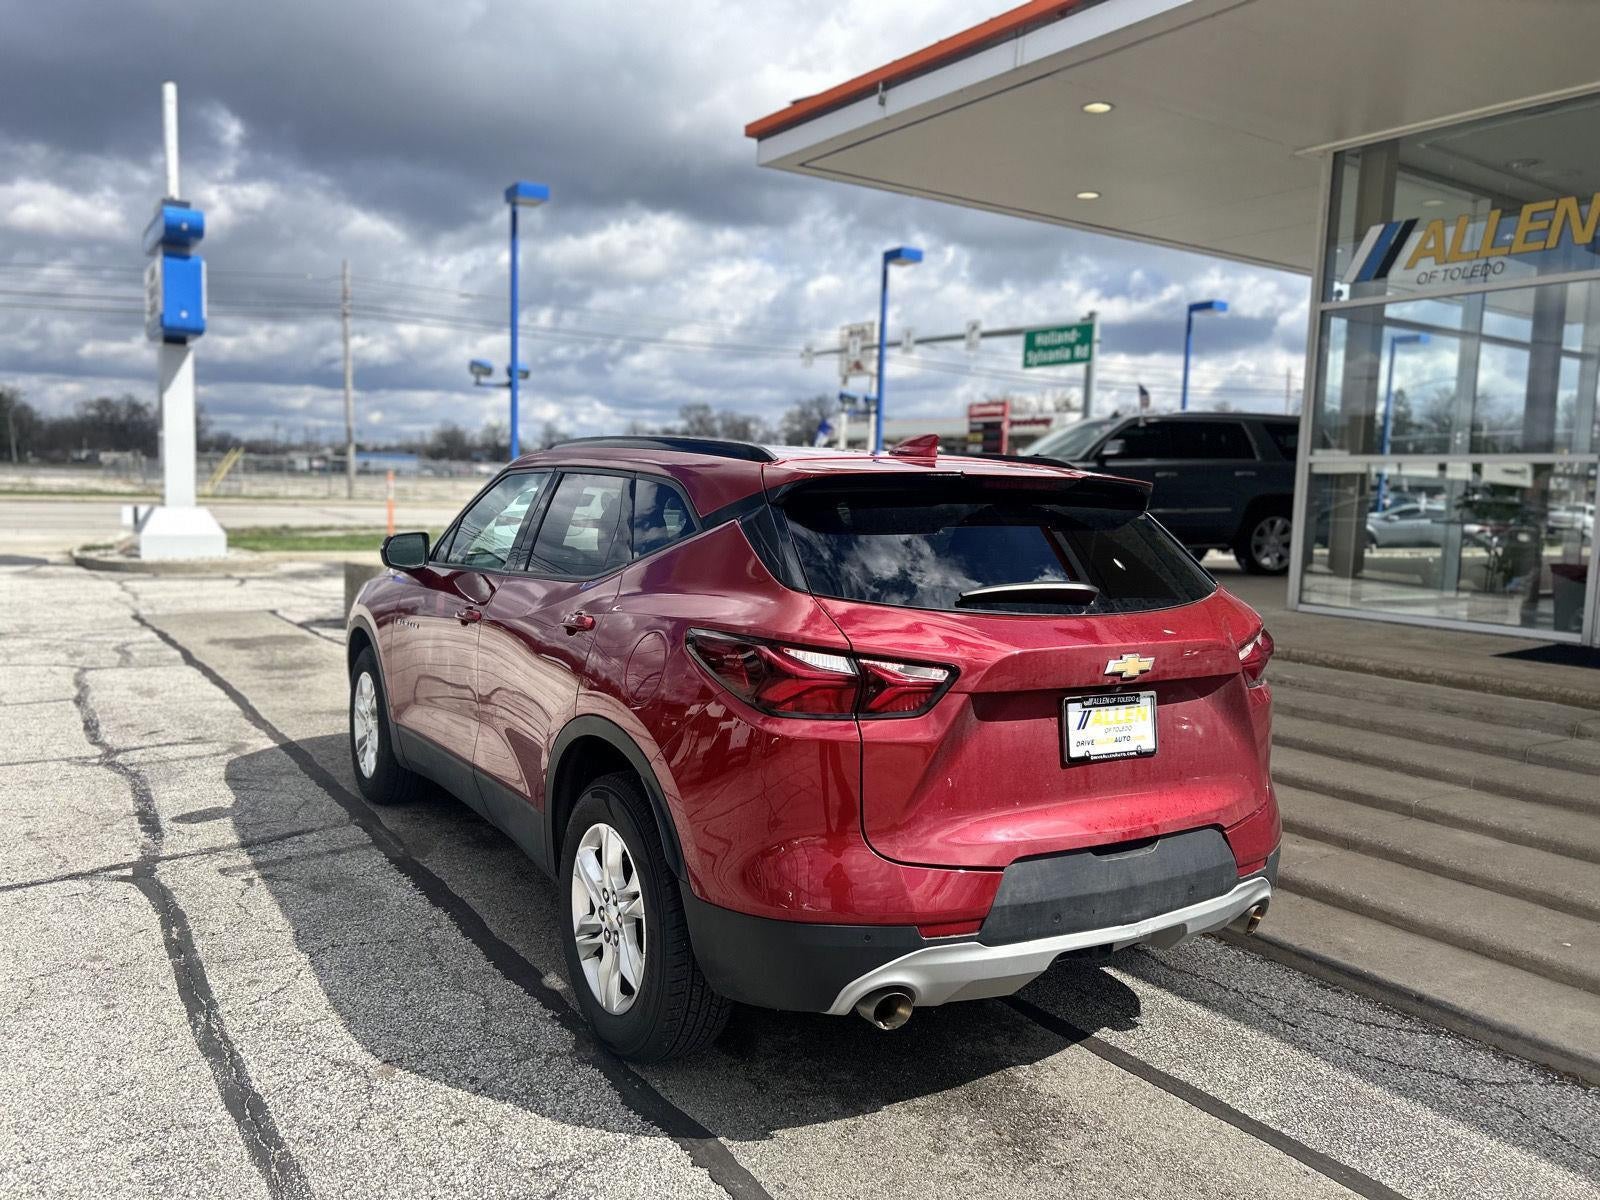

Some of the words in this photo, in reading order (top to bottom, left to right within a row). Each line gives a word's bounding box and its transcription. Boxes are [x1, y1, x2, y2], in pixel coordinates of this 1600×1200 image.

[1403, 192, 1600, 270] ALLEN
[1416, 270, 1438, 286] OF
[1443, 261, 1506, 282] TOLEDO
[1074, 344, 1090, 358] Rd
[1093, 697, 1110, 705] ALLEN
[1092, 706, 1147, 725] ALLEN
[1104, 726, 1112, 734] OF
[1076, 739, 1095, 748] DRIVE
